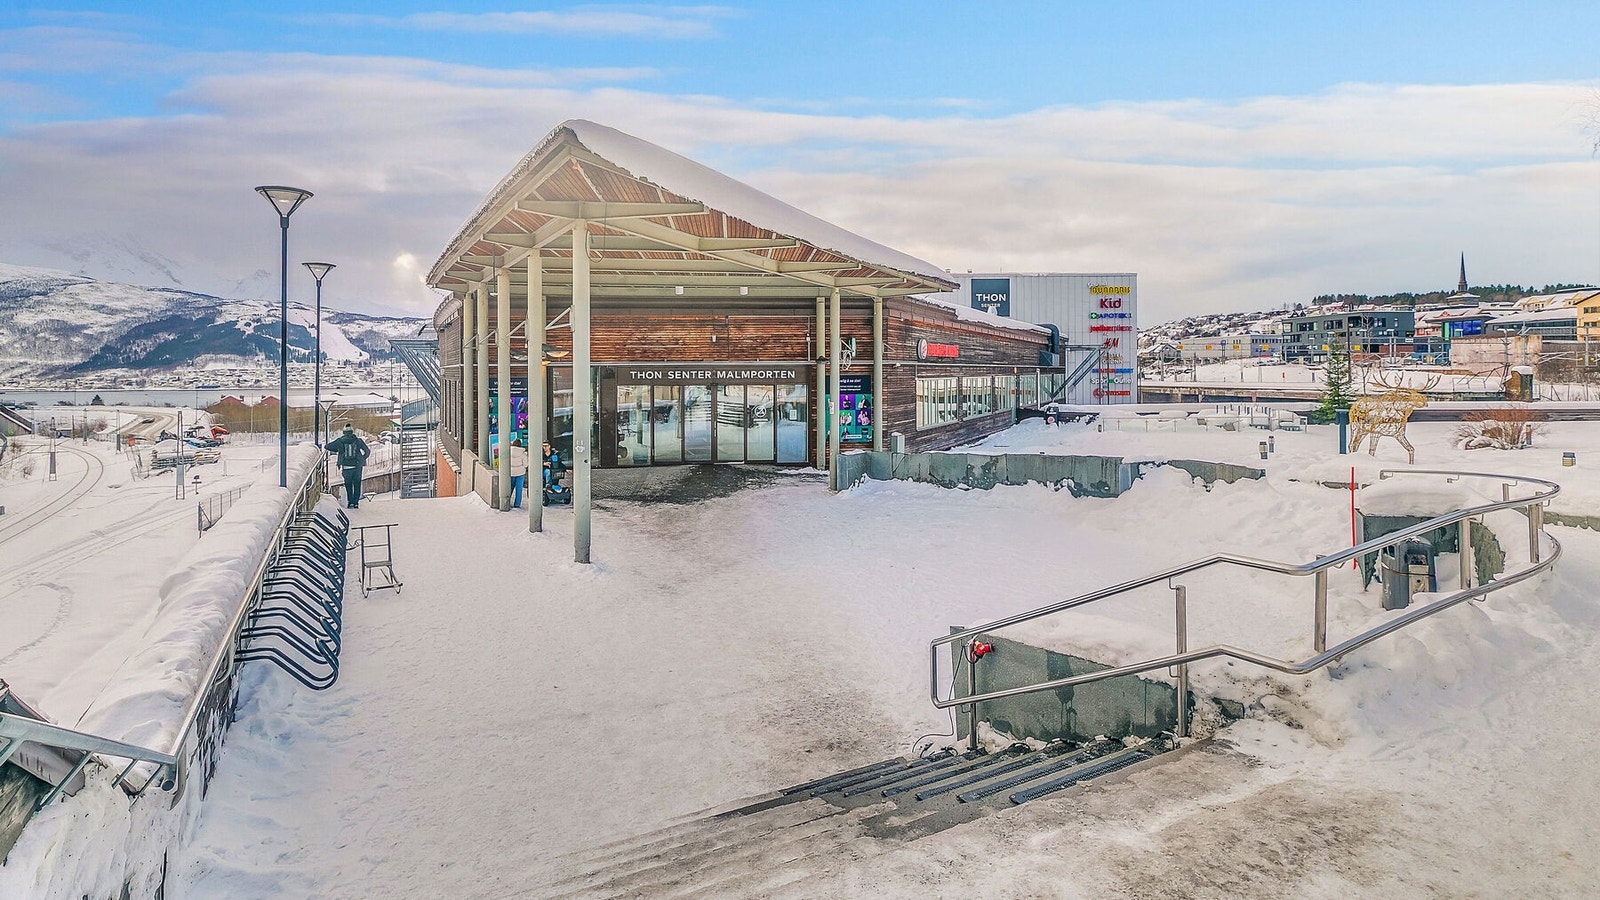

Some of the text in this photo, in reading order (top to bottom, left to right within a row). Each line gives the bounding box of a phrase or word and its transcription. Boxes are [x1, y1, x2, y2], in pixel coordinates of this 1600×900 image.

[976, 293, 1006, 302] THON
[1100, 298, 1122, 309] Kid
[629, 370, 796, 380] THON SENTER MALMPORTEN
[1091, 377, 1110, 385] Spor
